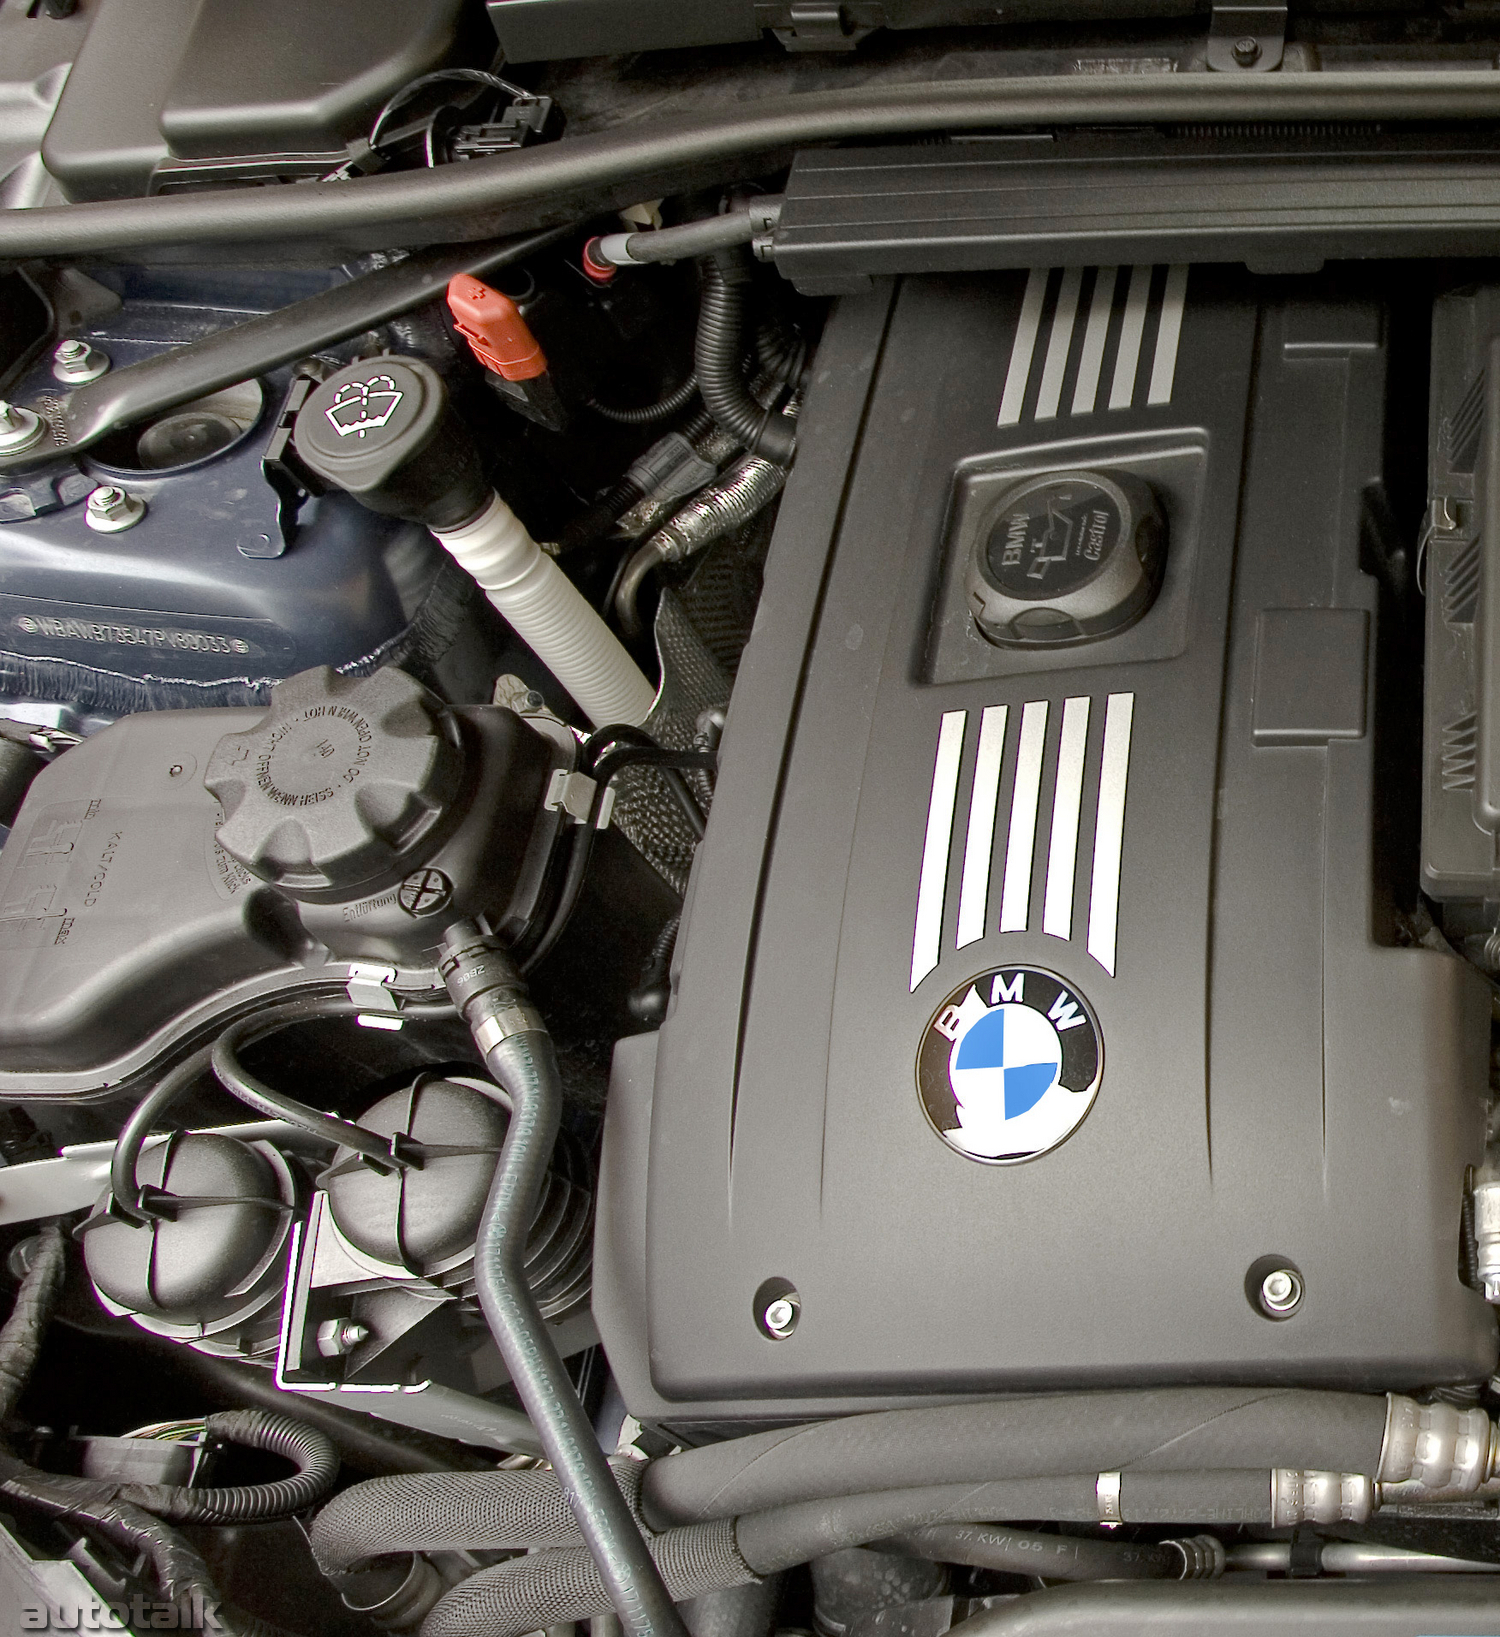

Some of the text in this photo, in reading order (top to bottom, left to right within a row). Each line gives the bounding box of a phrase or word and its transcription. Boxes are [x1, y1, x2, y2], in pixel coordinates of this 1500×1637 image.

[1001, 513, 1030, 566] BMW
[1084, 510, 1109, 561] Castrol
[303, 706, 326, 721] HOT
[353, 718, 372, 742] OPEN
[300, 787, 334, 806] HEISS
[84, 831, 122, 907] KALT/COLD
[343, 893, 397, 922] Entlüftung
[54, 918, 75, 945] max
[934, 972, 1087, 1042] BMW
